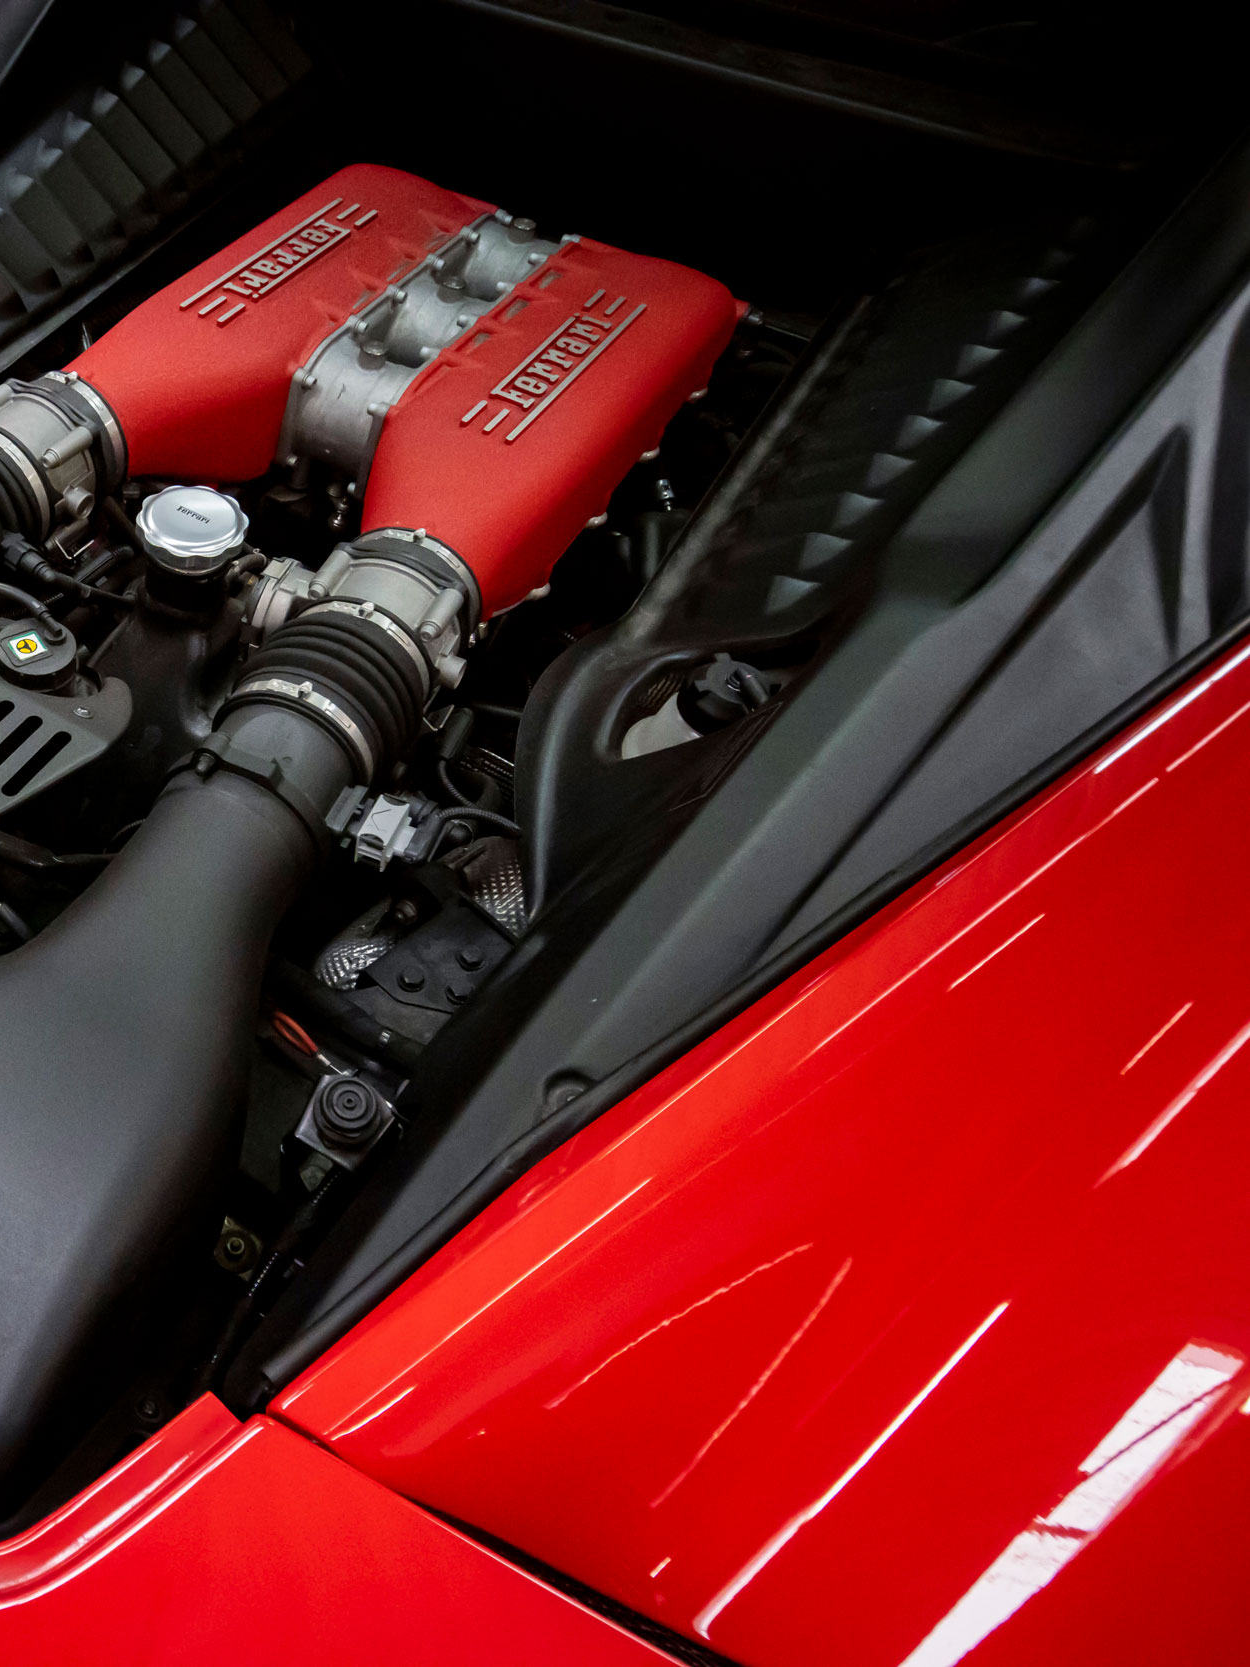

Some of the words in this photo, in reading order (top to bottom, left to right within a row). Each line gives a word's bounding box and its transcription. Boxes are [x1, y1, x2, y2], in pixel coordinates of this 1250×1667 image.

[222, 218, 351, 299] Ferrari
[490, 312, 612, 409] Ferrari
[176, 505, 211, 524] Ferrari
